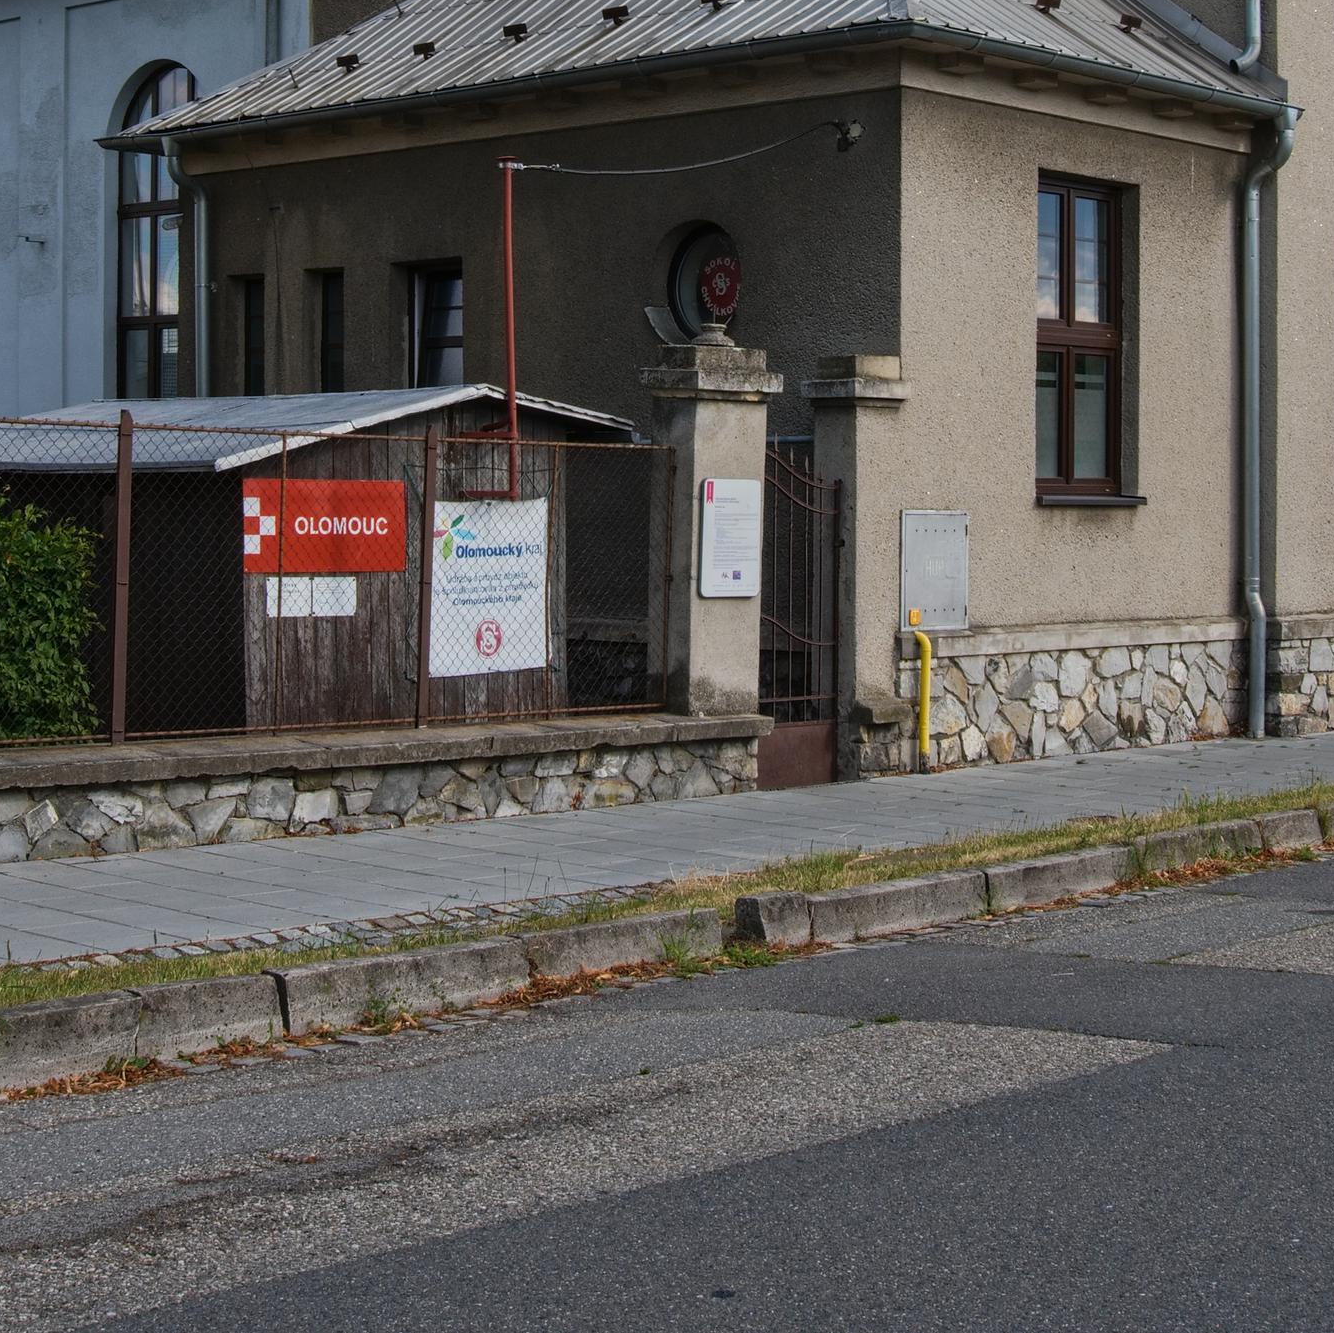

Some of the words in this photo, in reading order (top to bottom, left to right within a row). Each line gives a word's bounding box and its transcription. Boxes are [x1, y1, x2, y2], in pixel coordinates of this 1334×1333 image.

[704, 257, 737, 274] SOKOL
[294, 516, 388, 535] OLOMOUC
[455, 542, 523, 559] Olomoucký
[525, 540, 543, 556] kraj
